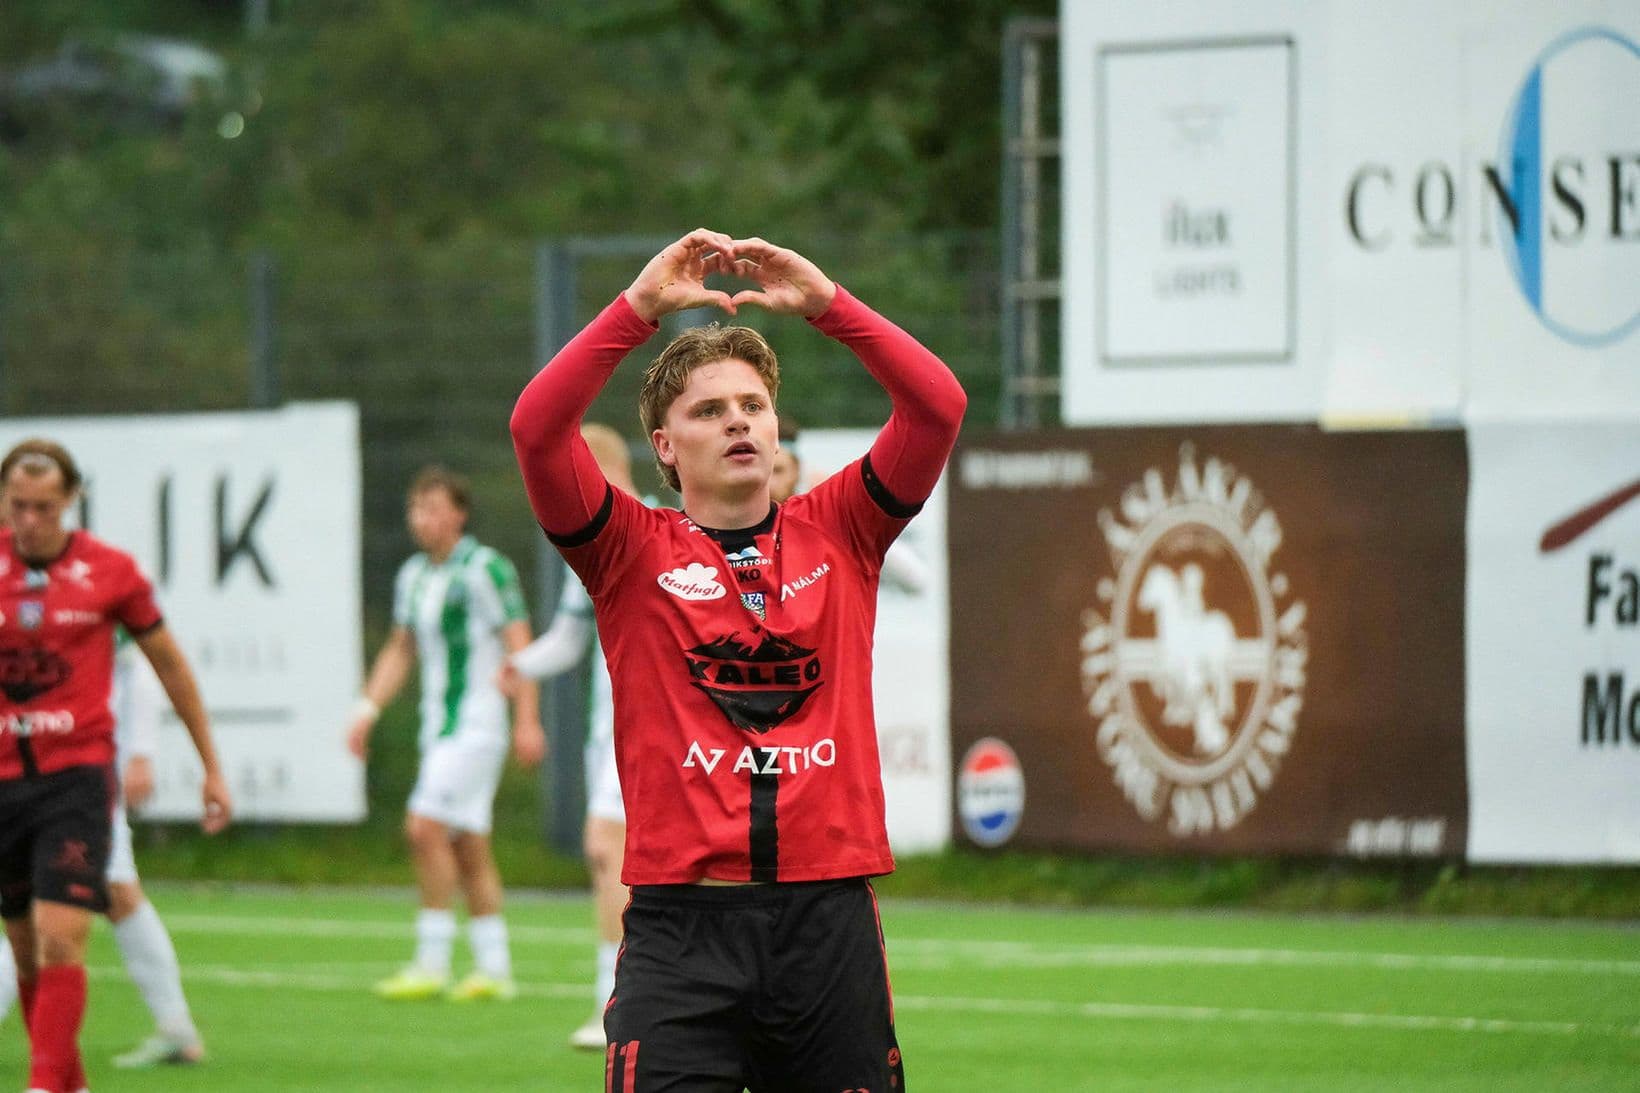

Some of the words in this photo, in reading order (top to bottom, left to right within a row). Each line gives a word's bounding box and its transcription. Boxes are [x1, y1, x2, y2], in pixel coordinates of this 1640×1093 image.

[661, 576, 720, 596] Matfugl
[687, 659, 821, 685] KALEO
[606, 1040, 640, 1093] 11
